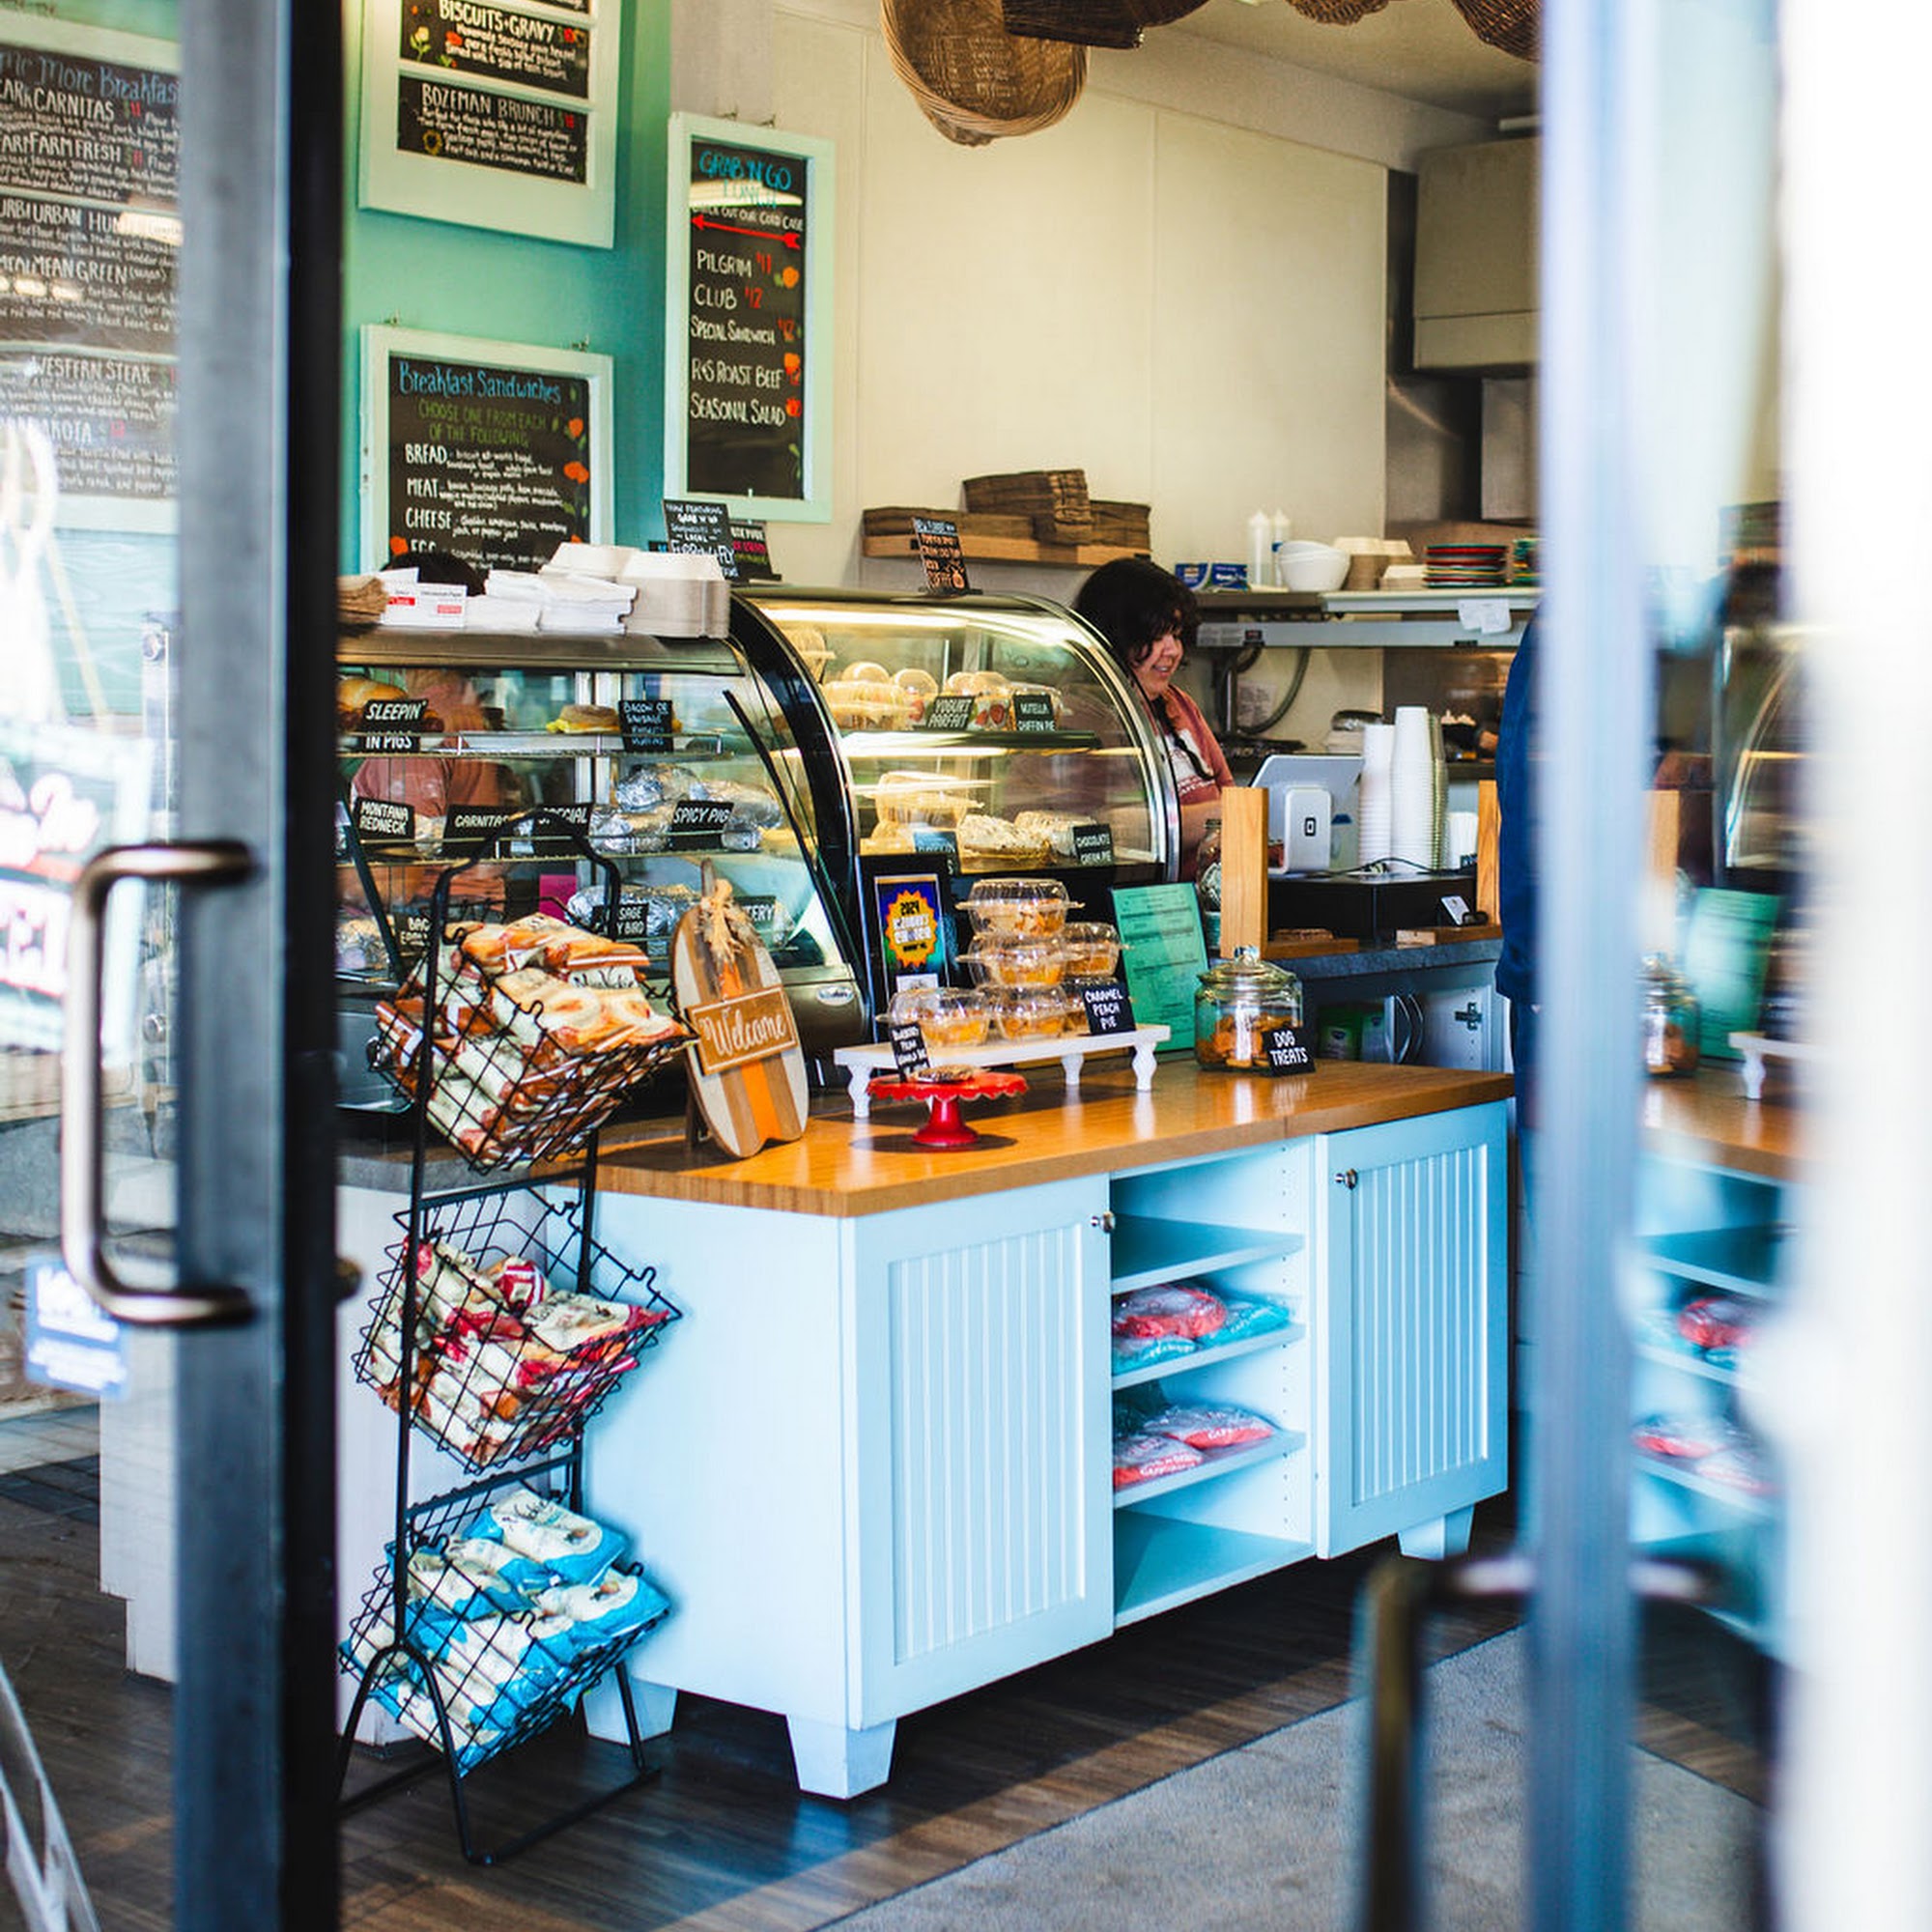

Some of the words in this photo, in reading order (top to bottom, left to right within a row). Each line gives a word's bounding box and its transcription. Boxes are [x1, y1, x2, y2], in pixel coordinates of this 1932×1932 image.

[99, 65, 181, 105] Breakfas
[34, 87, 115, 122] CARNITAS
[422, 83, 491, 114] BOZEMAN
[497, 99, 554, 127] BRUNCH
[74, 138, 122, 163] FRESH
[698, 150, 745, 179] GRAB
[765, 164, 792, 190] GO
[33, 203, 82, 227] URBAN
[76, 260, 128, 285] GREEN
[696, 249, 753, 277] PILGRIM
[694, 283, 738, 311] CLUB
[690, 315, 726, 341] SPECIAL
[105, 357, 152, 384] STEAK
[716, 360, 752, 386] ROAST
[755, 365, 783, 389] BEEF
[399, 361, 473, 398] Breakfast
[477, 370, 561, 405] Sandwiches
[418, 399, 460, 421] CHOOSE
[405, 443, 448, 465] BREAD
[407, 478, 438, 498] MEAT
[406, 507, 452, 529] CHEESE
[366, 700, 427, 722] SLEEPIN'
[360, 801, 409, 819] MONTANA
[673, 807, 710, 824] SPICY
[358, 815, 407, 836] REDNECK
[1084, 987, 1123, 1004] CARAMEL
[1093, 1003, 1121, 1017] PEACH
[698, 1007, 787, 1057] Welcome
[1100, 1016, 1118, 1031] PIE
[1273, 1030, 1296, 1048] DOG
[1268, 1045, 1309, 1067] TREATS
